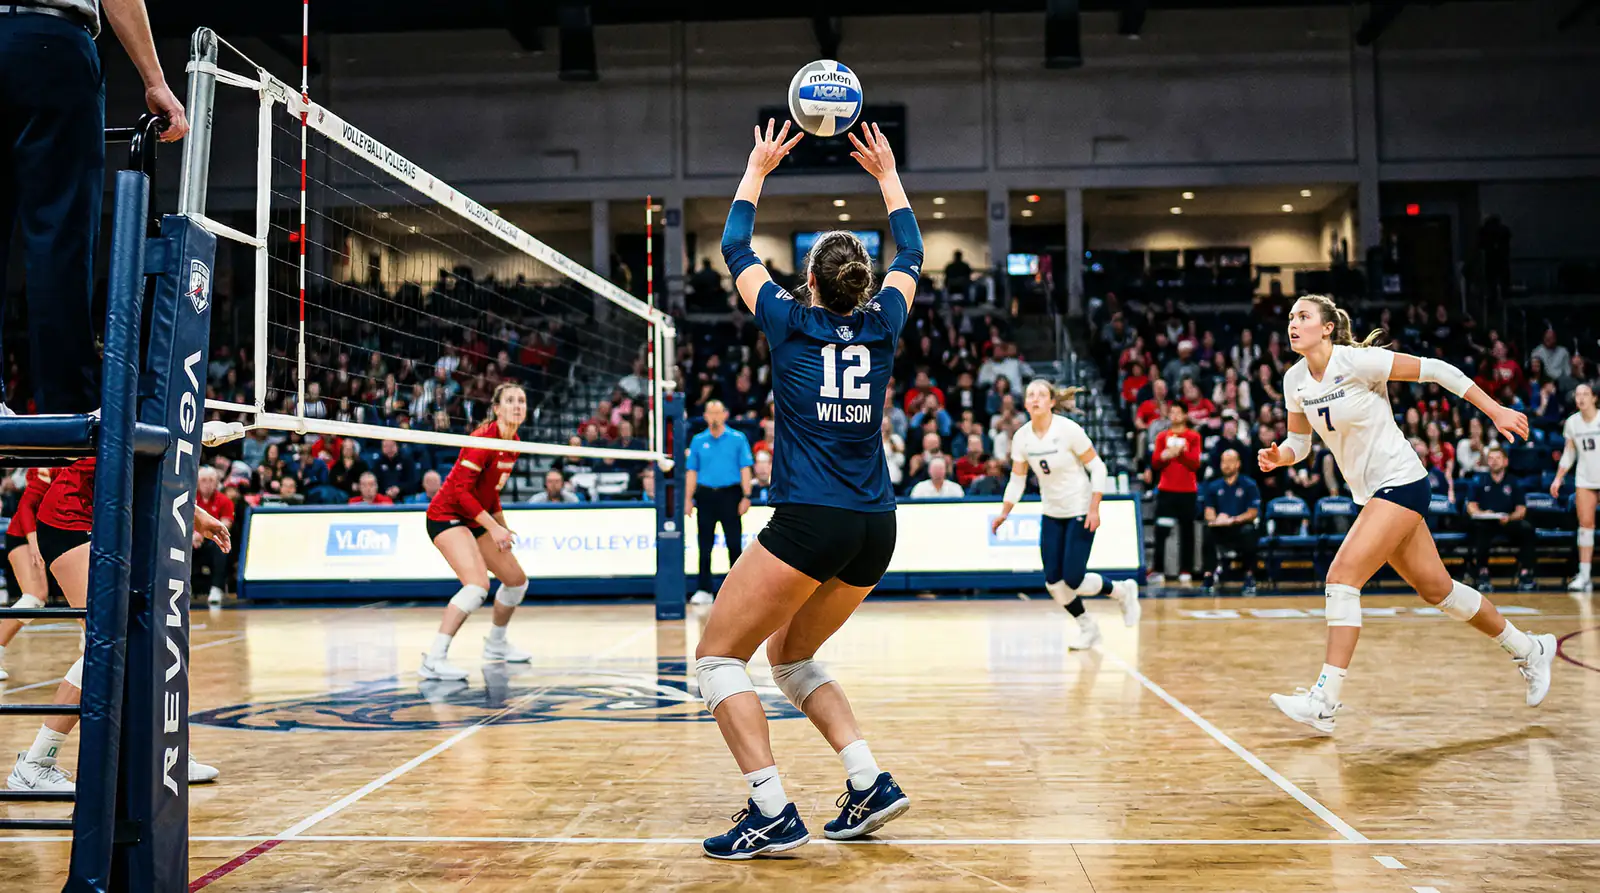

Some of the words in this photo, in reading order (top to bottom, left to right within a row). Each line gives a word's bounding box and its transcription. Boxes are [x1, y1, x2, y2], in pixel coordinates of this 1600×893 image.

[810, 72, 851, 86] molten
[342, 123, 382, 160] VOLLEYBALL
[820, 343, 871, 399] 12
[816, 402, 872, 423] WILSON
[1317, 406, 1336, 432] 7
[1039, 459, 1051, 474] 9
